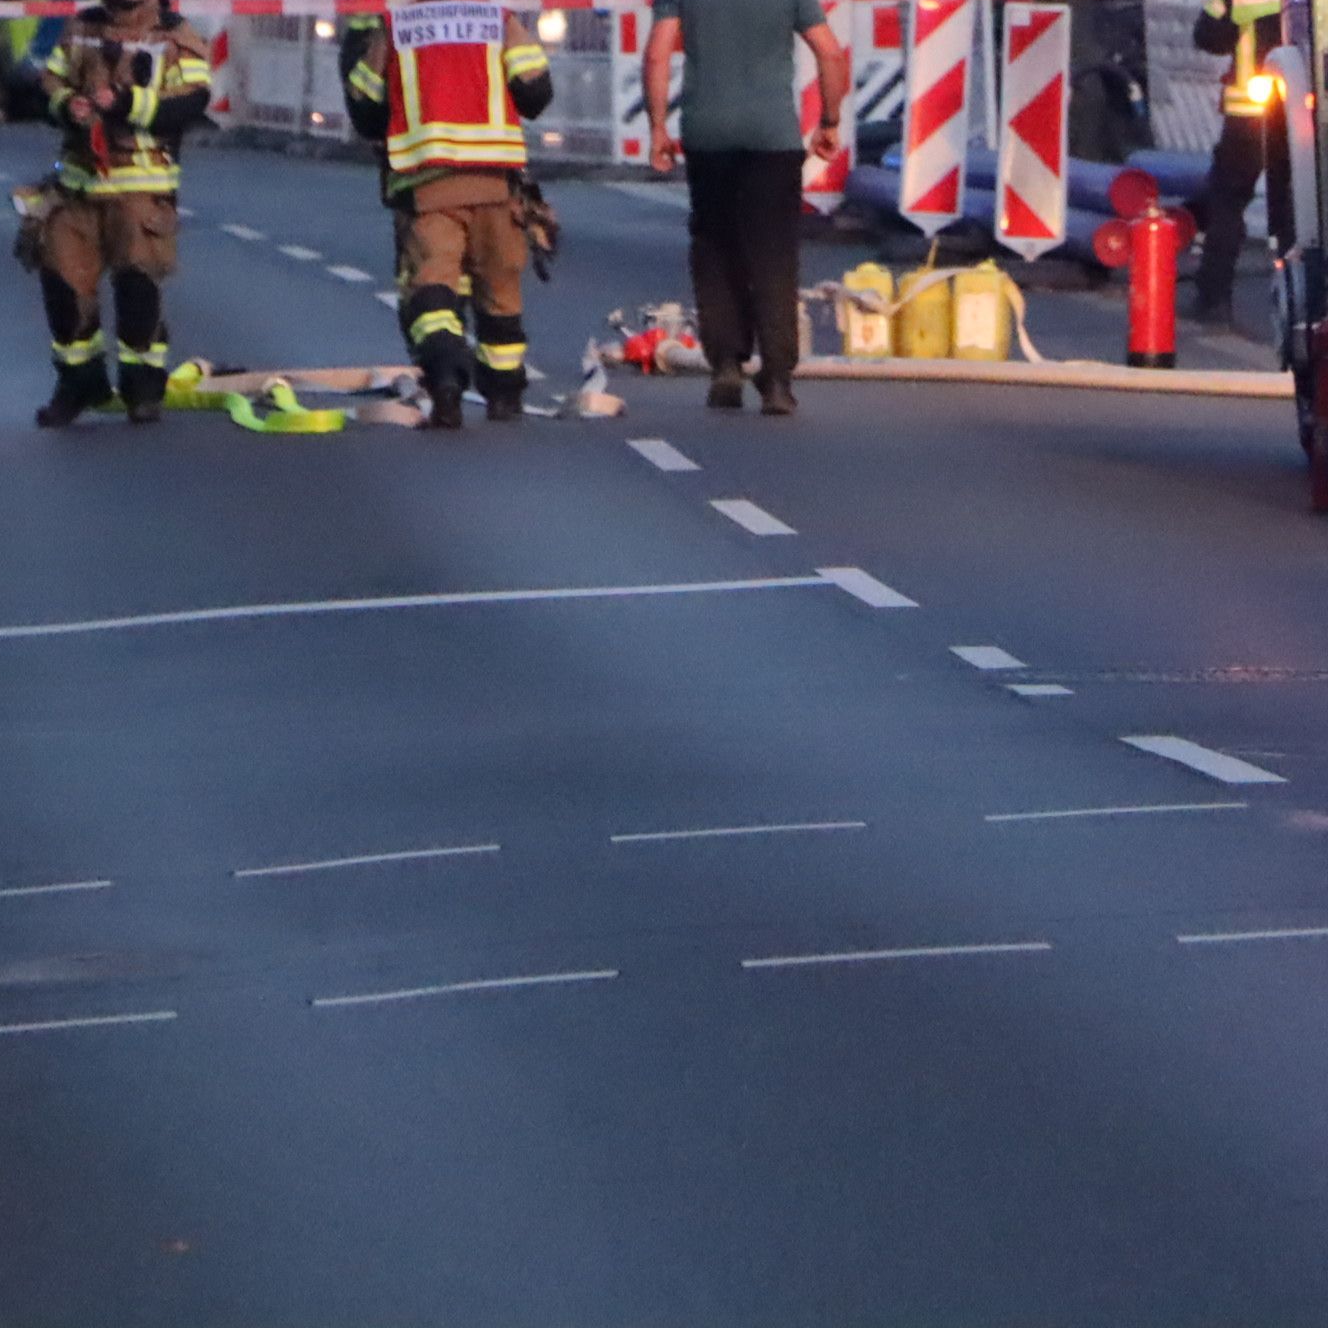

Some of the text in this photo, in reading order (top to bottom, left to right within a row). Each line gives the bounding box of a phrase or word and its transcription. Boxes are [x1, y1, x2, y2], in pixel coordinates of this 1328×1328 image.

[397, 22, 499, 45] WSS 1 LF 20
